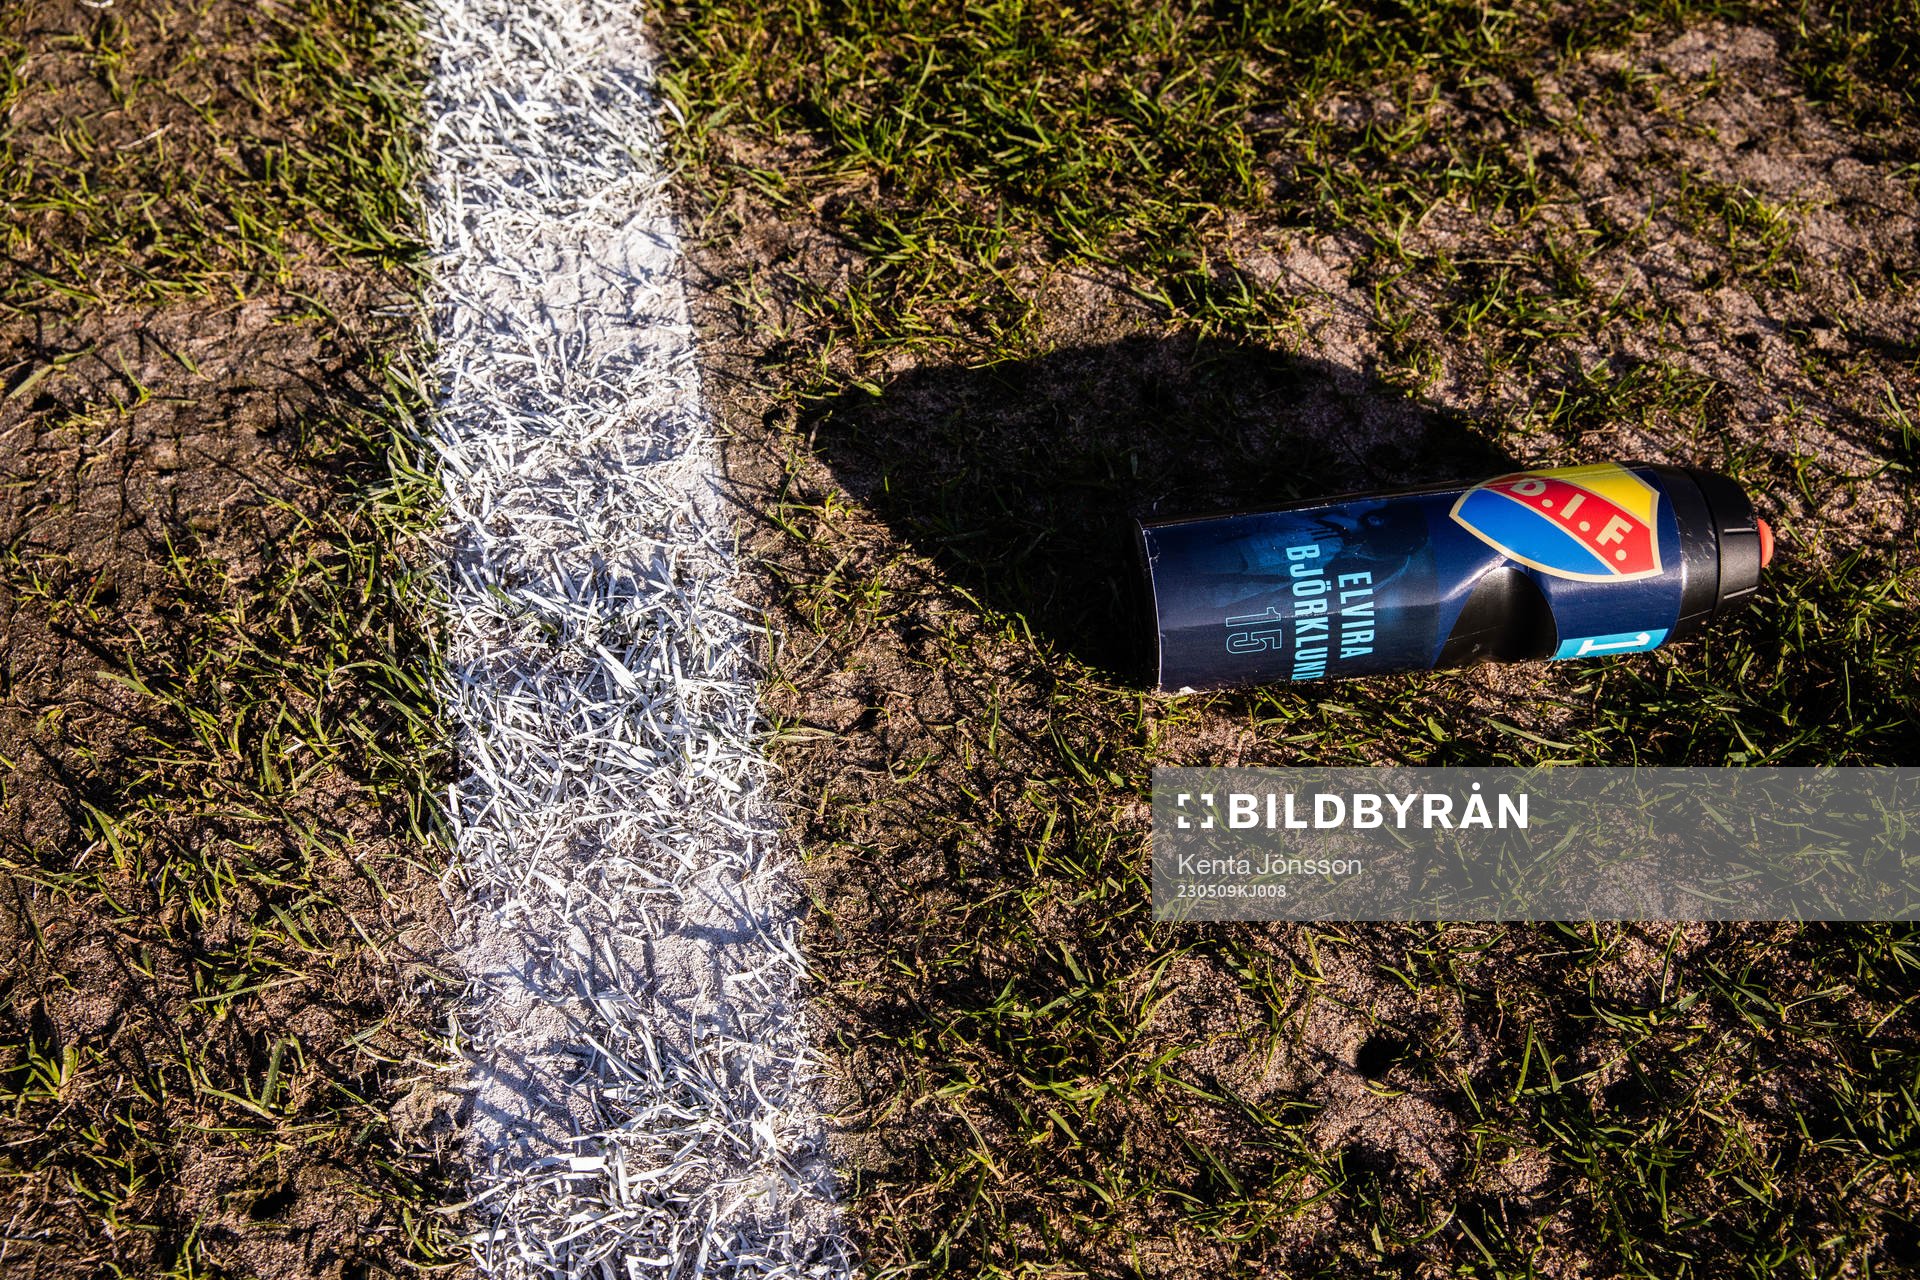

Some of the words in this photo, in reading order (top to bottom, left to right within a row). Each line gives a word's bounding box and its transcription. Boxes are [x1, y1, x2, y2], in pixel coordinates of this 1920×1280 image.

[1225, 606, 1282, 655] 15
[1286, 544, 1329, 681] BJÖRKLUND
[1338, 571, 1375, 659] ELVIRA
